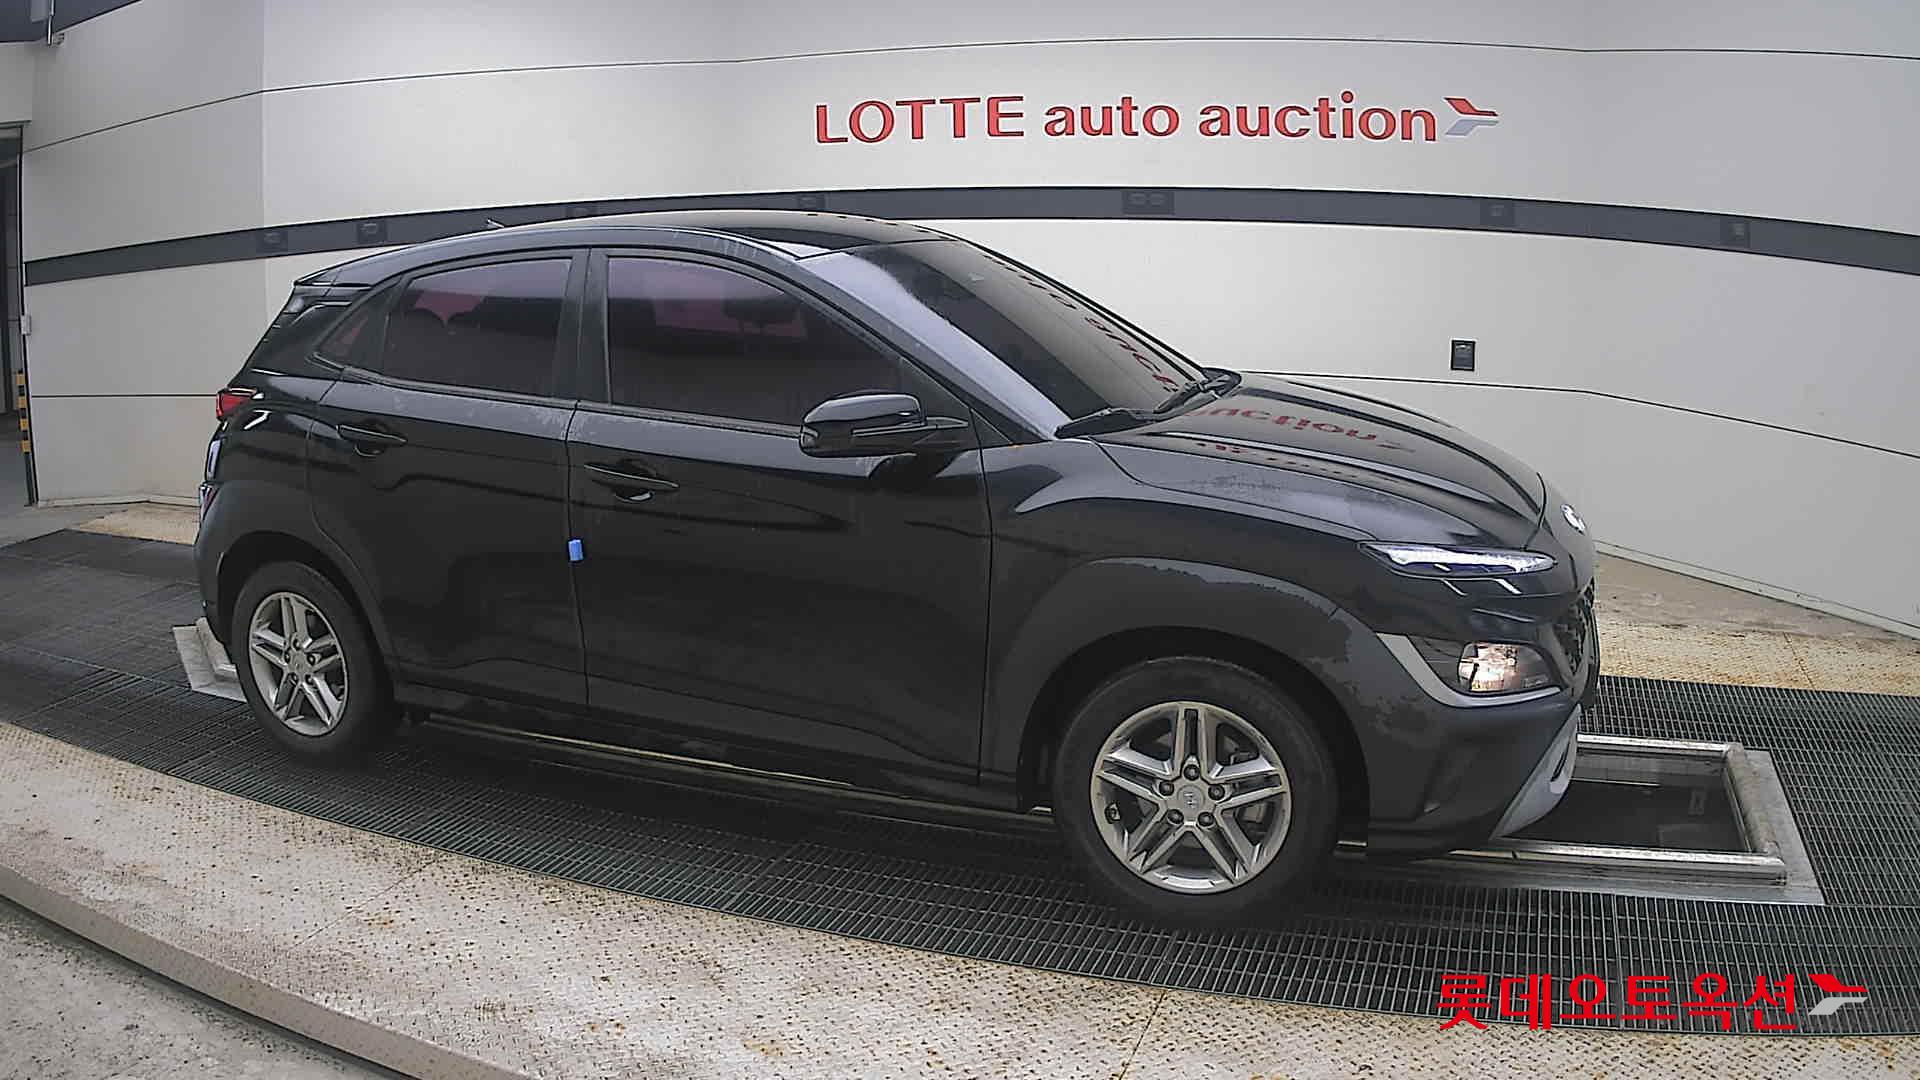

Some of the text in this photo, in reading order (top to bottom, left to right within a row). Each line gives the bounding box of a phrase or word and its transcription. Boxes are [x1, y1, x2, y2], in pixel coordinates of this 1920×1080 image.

[815, 90, 1438, 144] LOTTE auto auction
